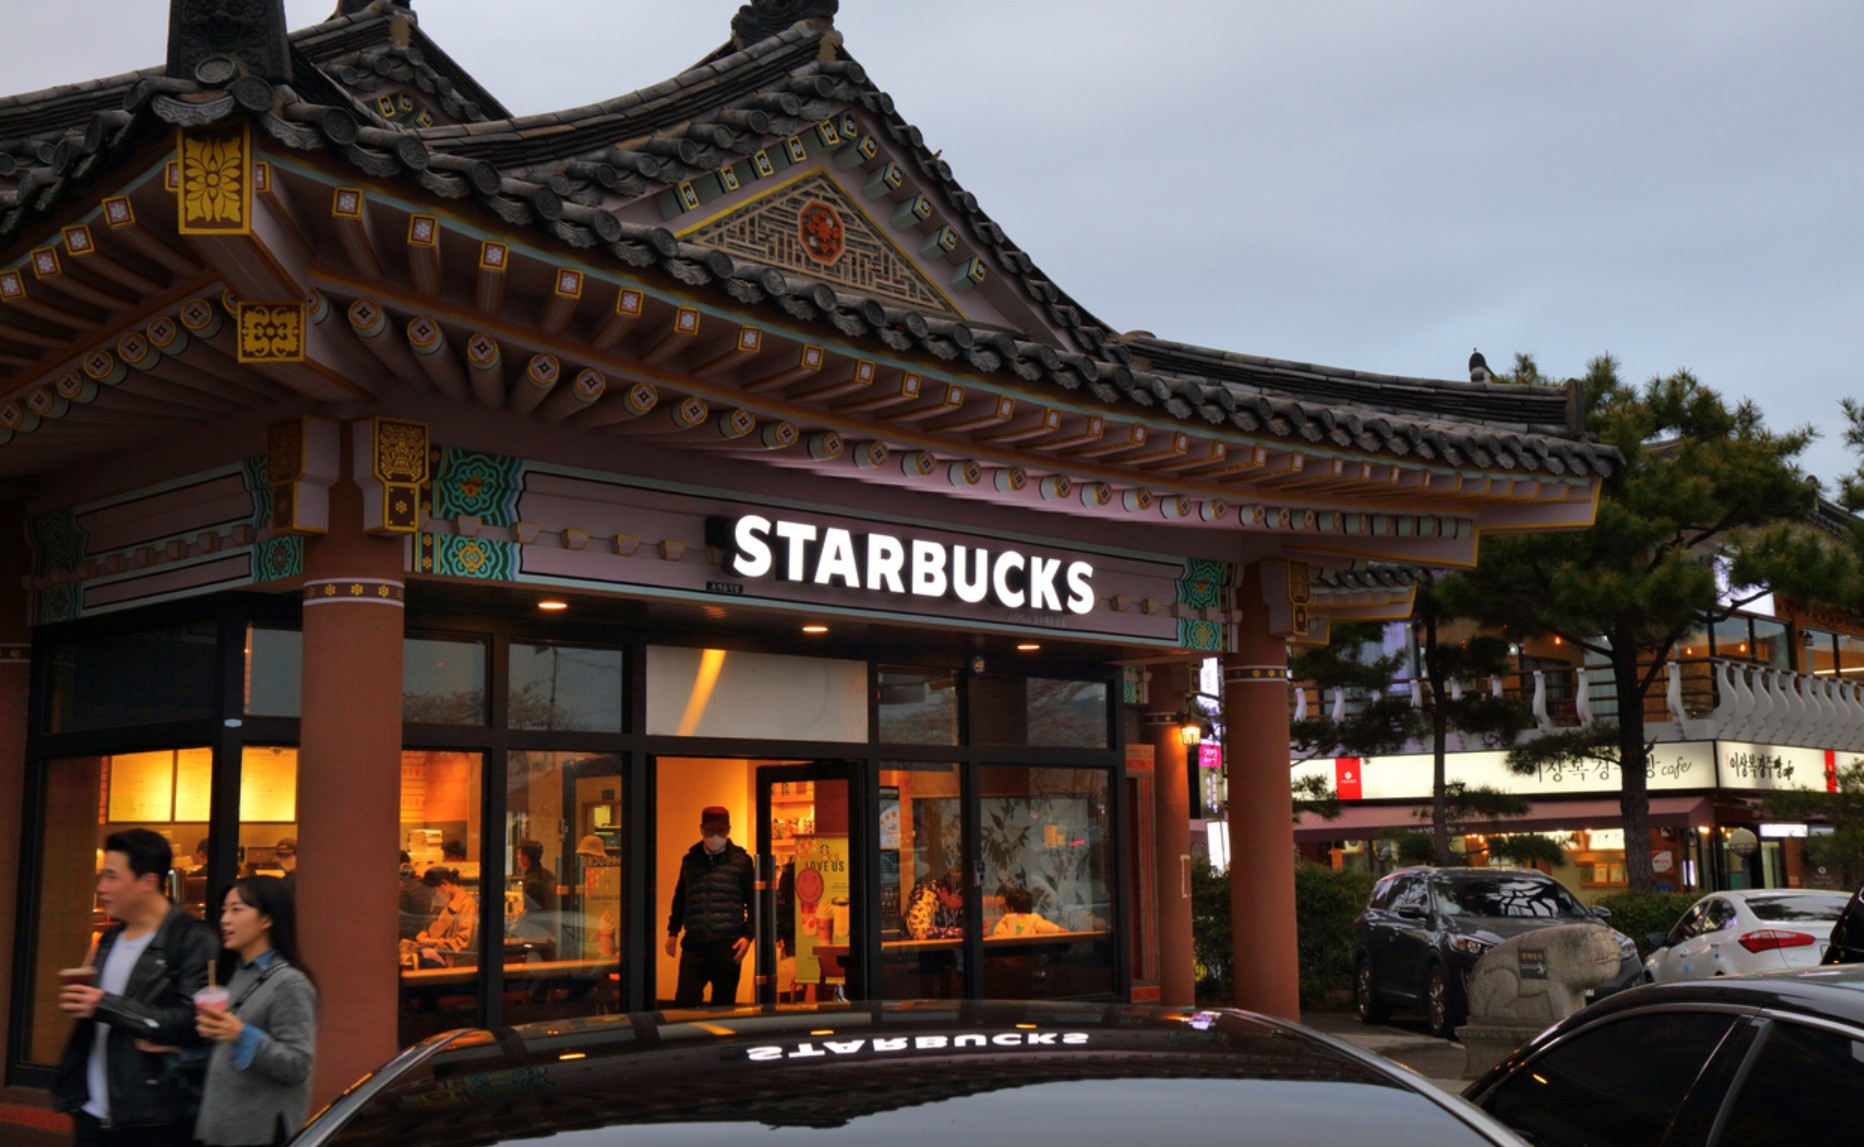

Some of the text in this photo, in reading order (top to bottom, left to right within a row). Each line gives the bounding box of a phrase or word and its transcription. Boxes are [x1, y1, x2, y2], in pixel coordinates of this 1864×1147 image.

[733, 514, 1096, 616] STARBUCKS
[1660, 755, 1692, 780] cafe
[831, 860, 845, 872] US
